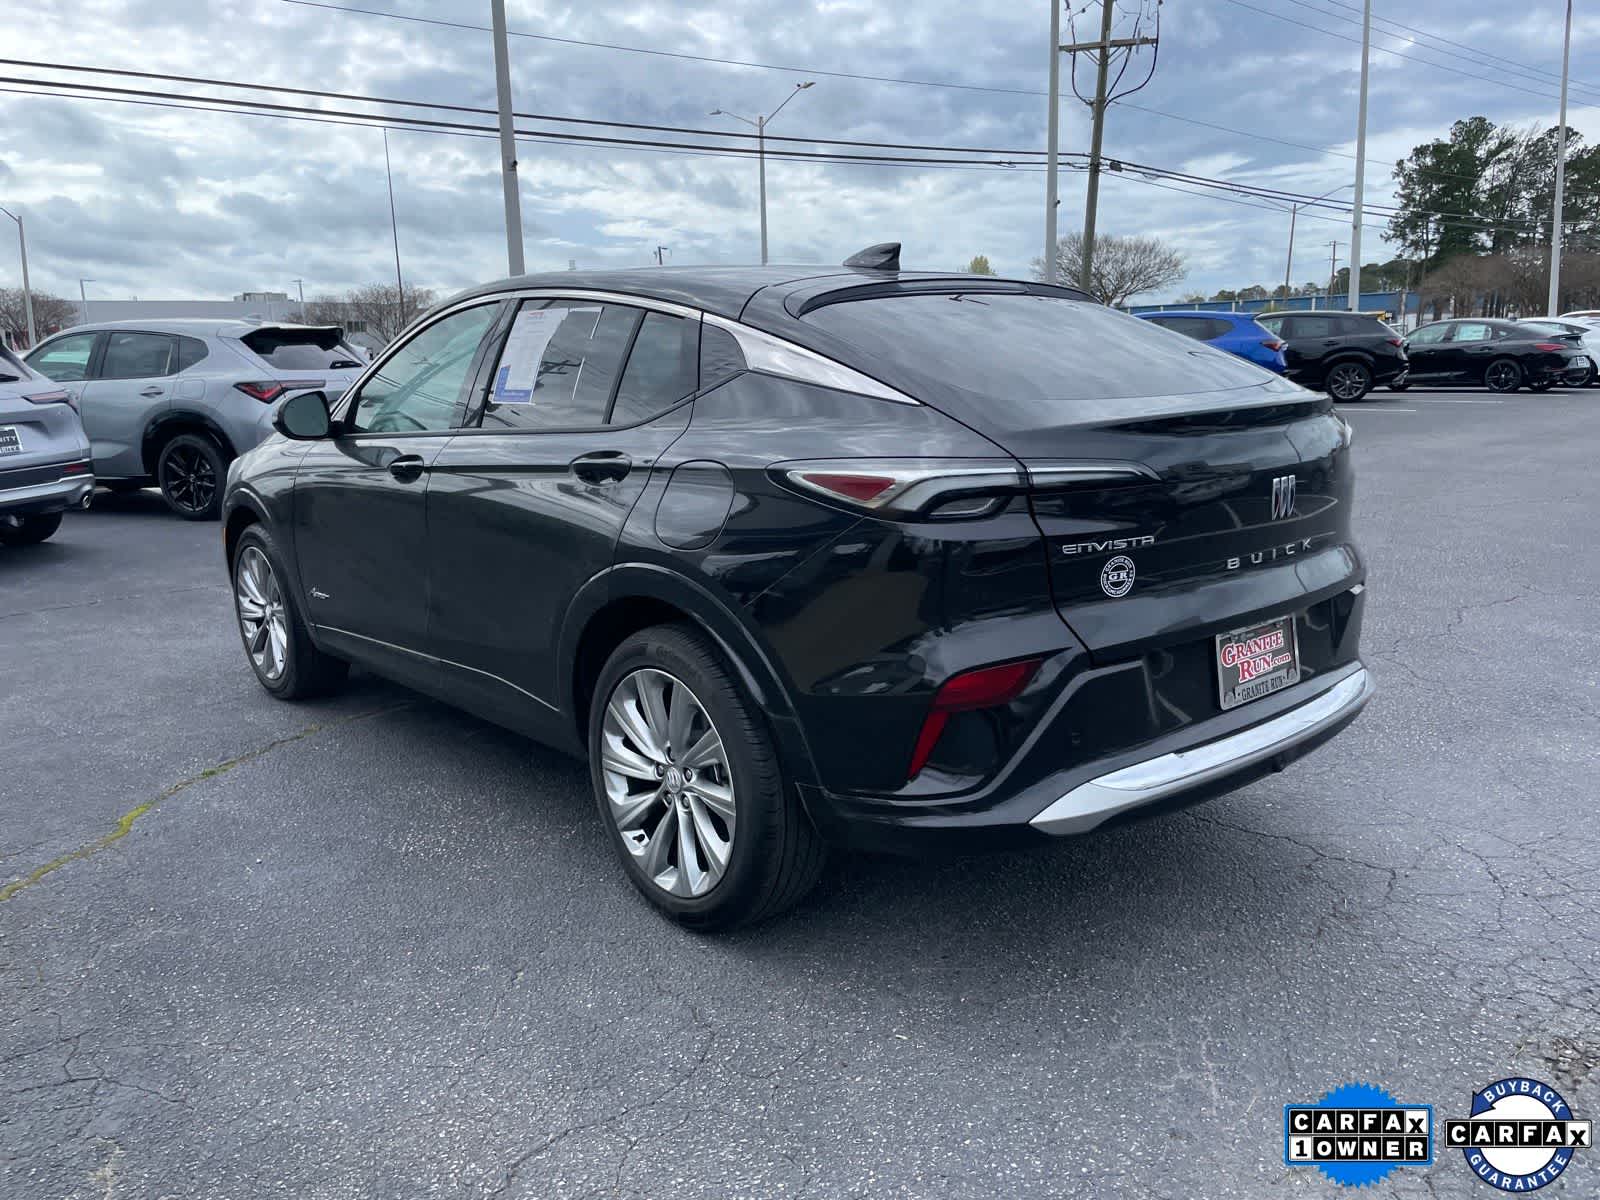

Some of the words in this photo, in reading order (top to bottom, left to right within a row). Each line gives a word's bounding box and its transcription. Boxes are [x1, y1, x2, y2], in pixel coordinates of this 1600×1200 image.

[1062, 535, 1155, 554] ENVISTA
[1226, 537, 1311, 569] BUICK
[1108, 572, 1128, 580] GR
[1222, 631, 1283, 667] GRANITE
[1239, 653, 1291, 683] RUN.com
[1242, 681, 1269, 700] GRANITE
[1270, 676, 1283, 690] RUN
